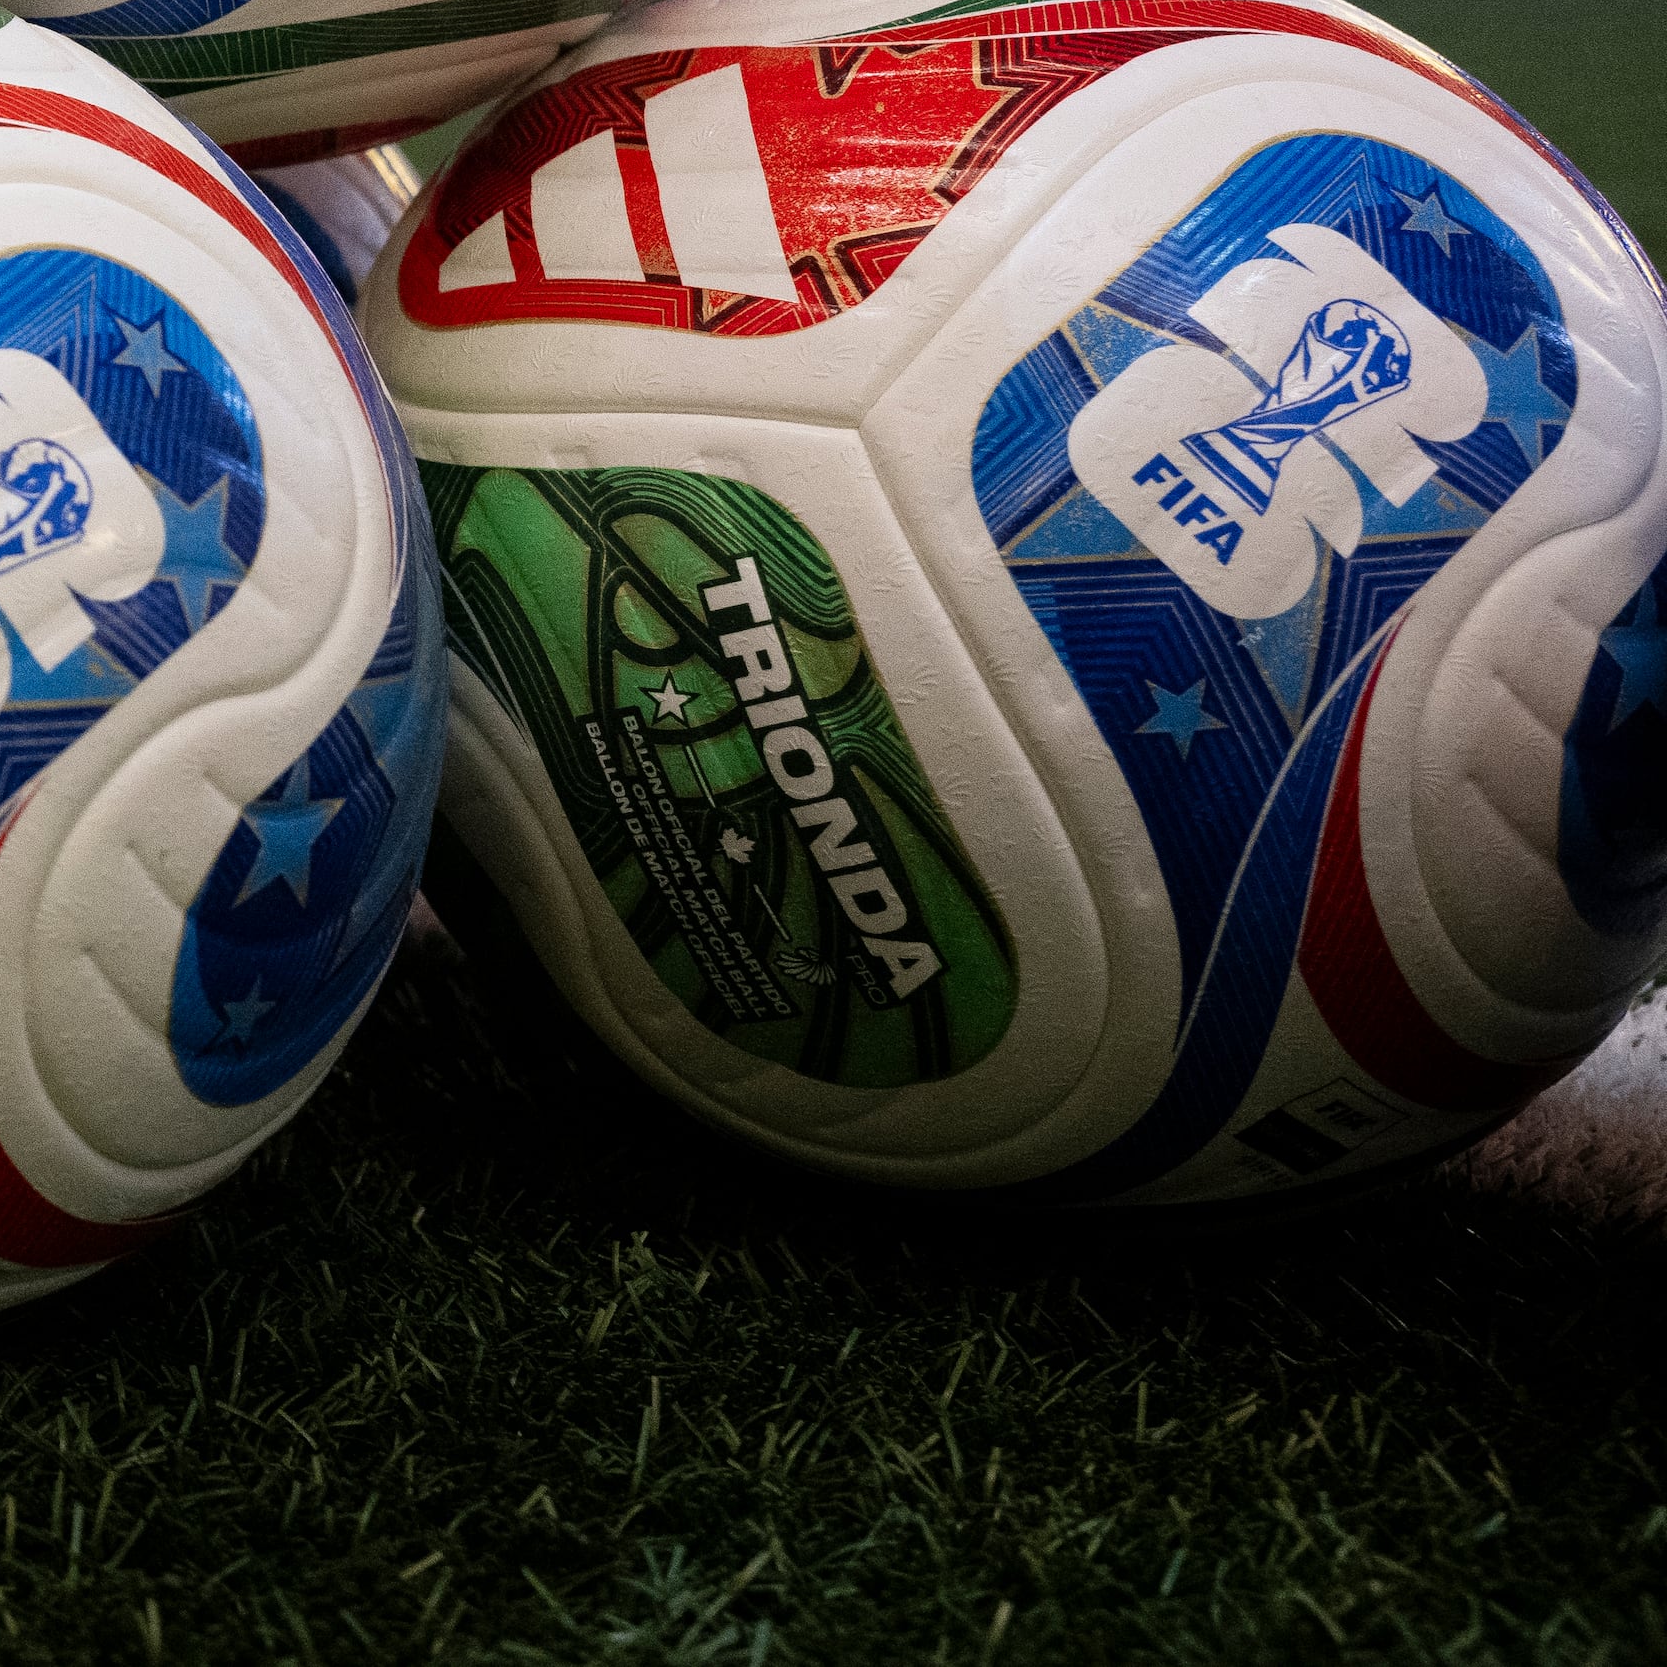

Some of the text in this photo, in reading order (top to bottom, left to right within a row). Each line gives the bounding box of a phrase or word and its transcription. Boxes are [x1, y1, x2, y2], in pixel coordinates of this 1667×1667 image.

[1131, 452, 1247, 566] FIFA
[585, 721, 751, 1021] BALLON DE MATCH OFFICIEL
[703, 554, 944, 1001] TRIONDA
[631, 783, 766, 1019] OFFICIAL MATCH BALL
[657, 797, 708, 885] OFICIAL
[702, 887, 728, 930] DEL
[727, 931, 792, 1016] PARTIDO
[844, 954, 888, 1005] PRO
